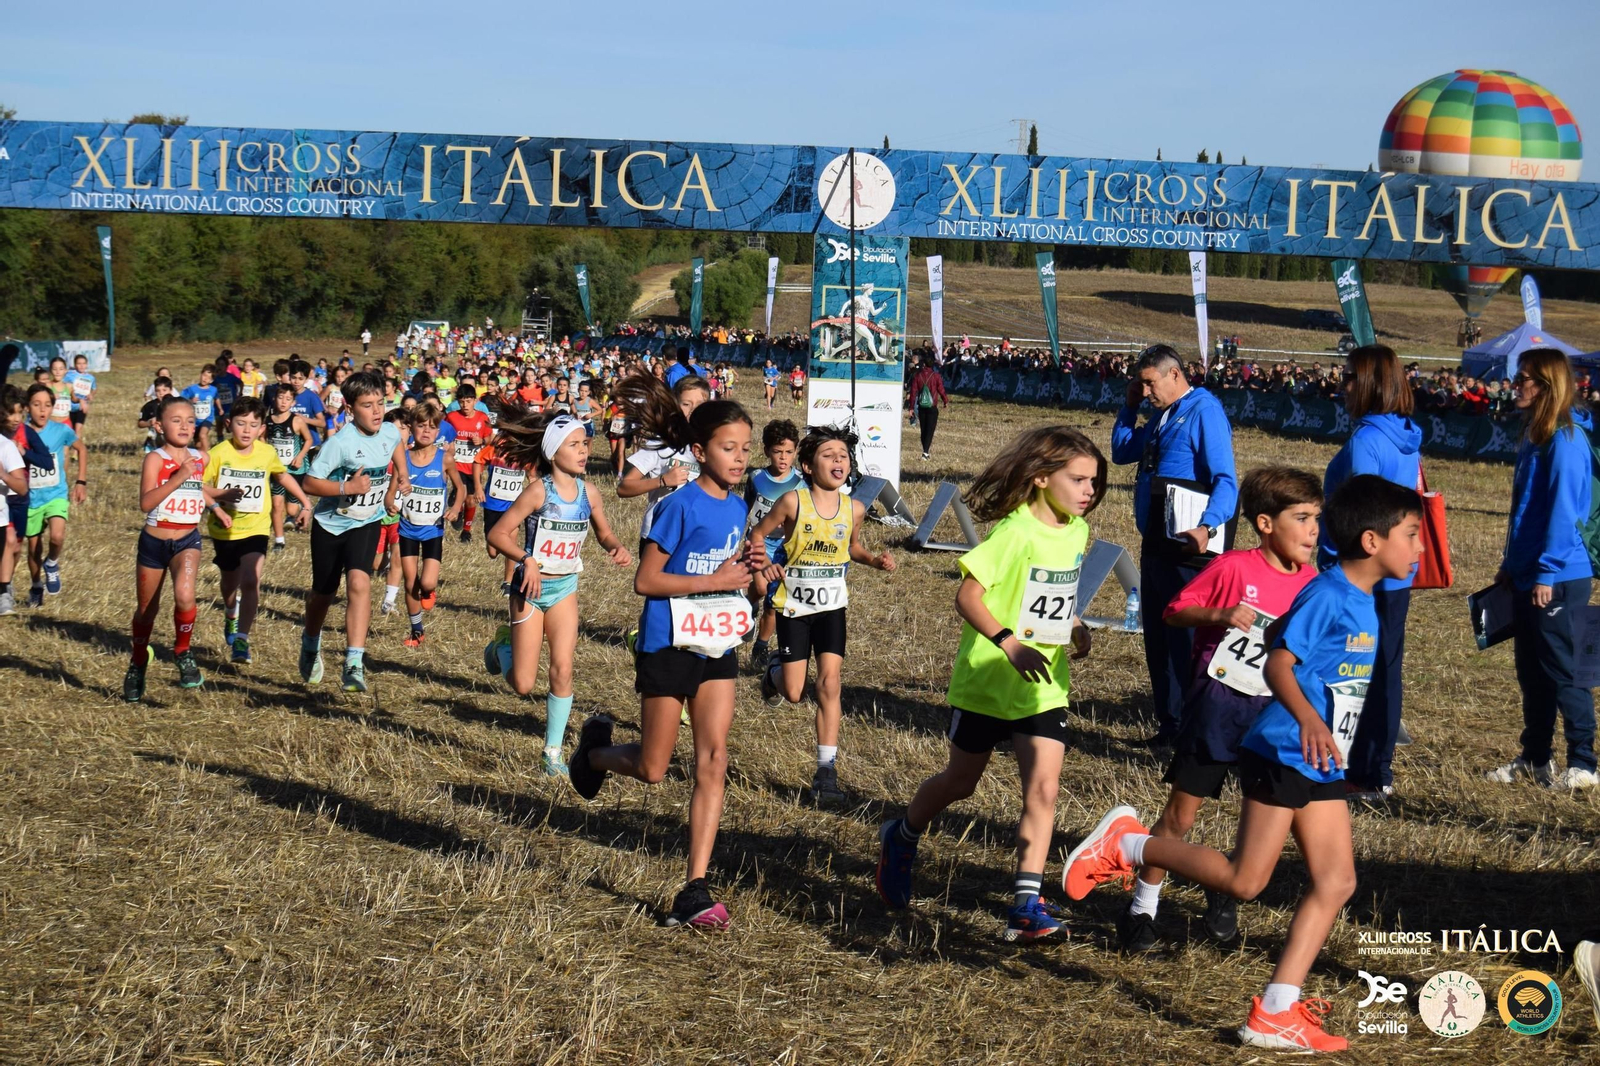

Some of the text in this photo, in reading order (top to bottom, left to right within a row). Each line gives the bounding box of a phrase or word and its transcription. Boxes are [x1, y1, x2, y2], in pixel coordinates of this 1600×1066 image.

[71, 136, 363, 192] XLIII CROSS
[419, 136, 722, 212] ITÁLICA
[1510, 159, 1565, 180] Hay otra
[236, 176, 407, 197] INTERNACIONAL
[939, 164, 1228, 222] XLIII CROSS
[71, 192, 376, 216] INTERNATIONAL CROSS COUNTRY
[1283, 171, 1583, 251] ITÁLICA
[1103, 206, 1271, 230] INTERNACIONAL
[938, 220, 1241, 249] INTERNATIONAL CROSS COUNTRY
[863, 253, 896, 263] Sevilla
[494, 479, 522, 491] 4107
[165, 498, 204, 515] 4436
[406, 498, 441, 513] 4118
[556, 522, 581, 530] ITÁLICA
[540, 539, 582, 559] 4420
[802, 568, 830, 577] ITÁLICA
[792, 586, 842, 606] 4207
[681, 611, 750, 637] 4433
